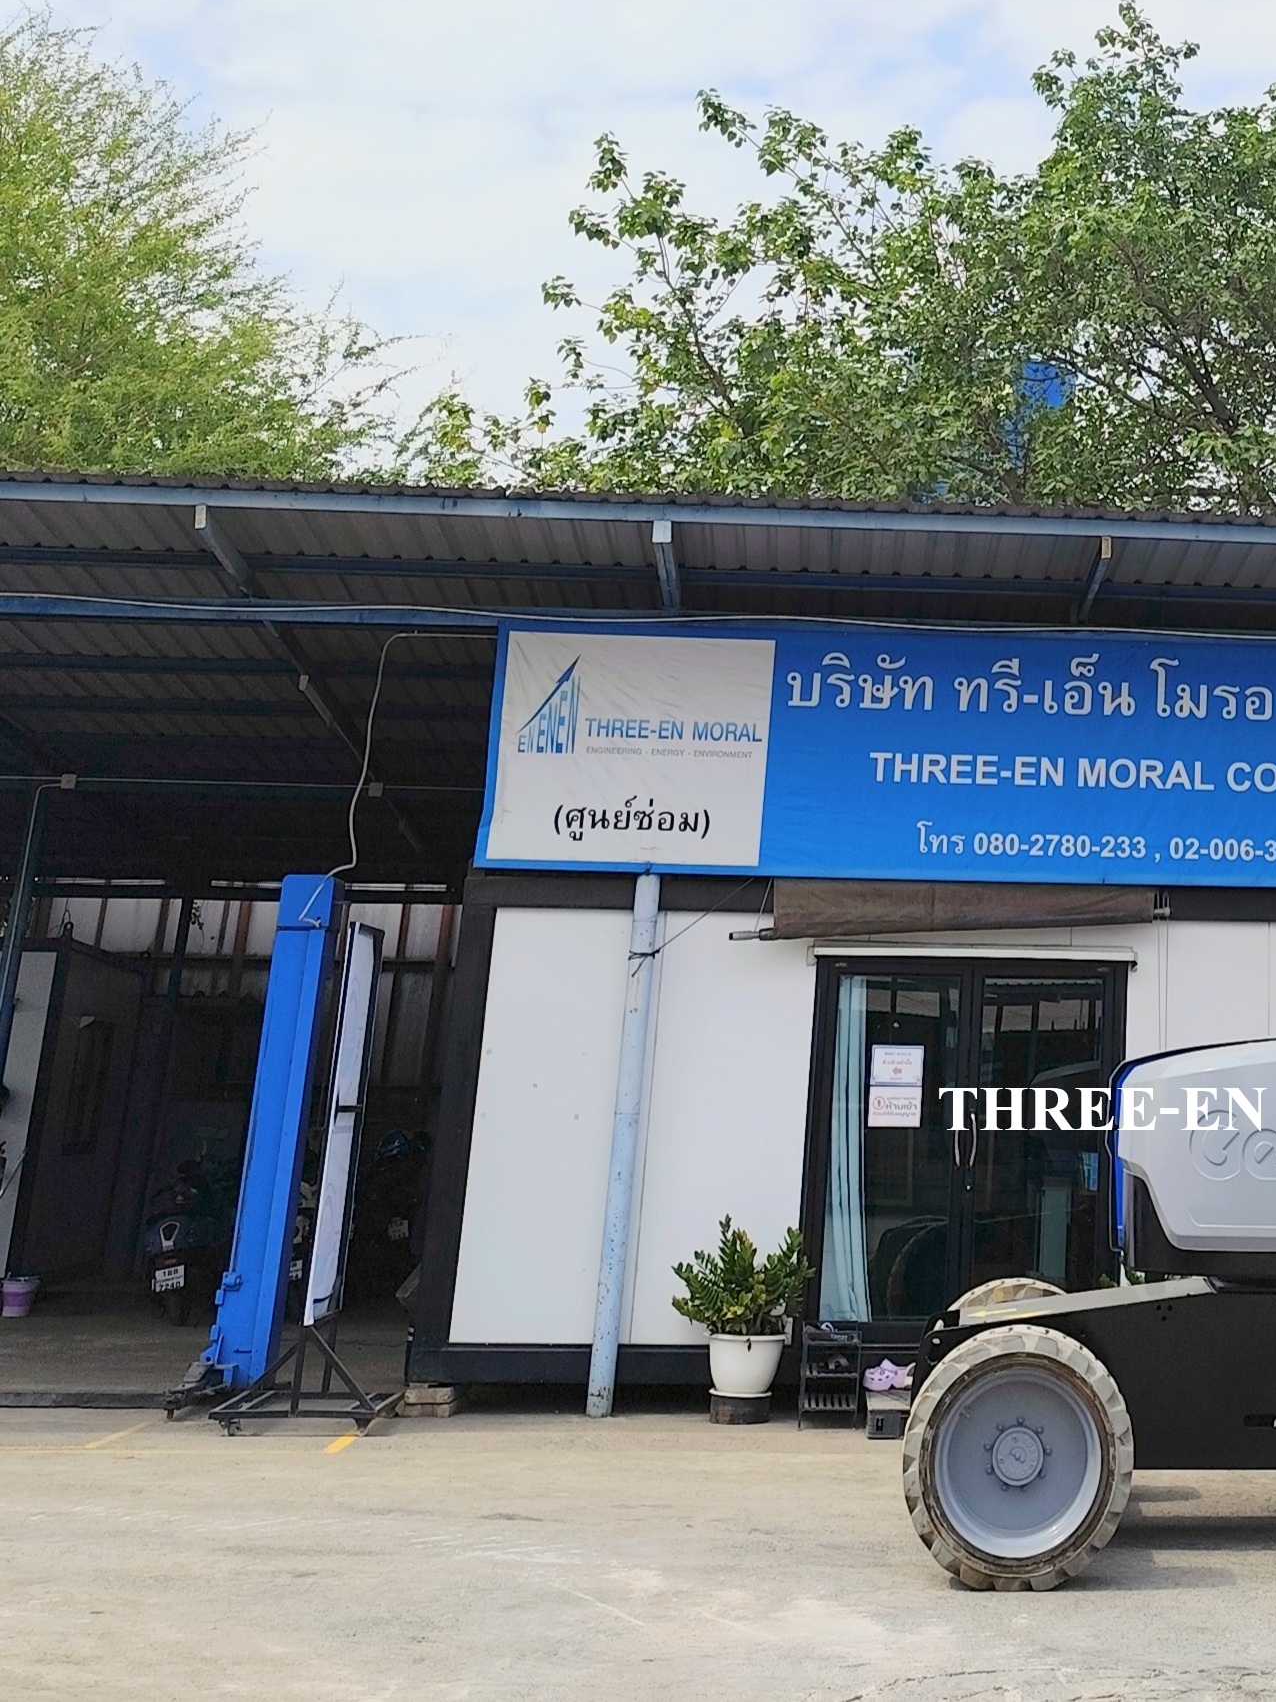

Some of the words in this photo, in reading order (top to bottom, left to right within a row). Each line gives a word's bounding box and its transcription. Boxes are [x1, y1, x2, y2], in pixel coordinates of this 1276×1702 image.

[787, 652, 934, 711] บริษัท
[954, 653, 1136, 717] ทรี-เอ็น
[585, 718, 684, 741] THREE-EN
[692, 721, 763, 743] MORAL
[586, 746, 643, 757] ENGINEERING
[651, 748, 685, 757] ENERGY
[693, 749, 753, 759] ENVIRONMENT
[869, 752, 1065, 787] THREE-EN
[1077, 758, 1215, 791] MORAL
[553, 795, 711, 842] (ศูนย์ซ่อม)
[916, 820, 966, 855] โทร
[973, 832, 1147, 859] 080-2780-233
